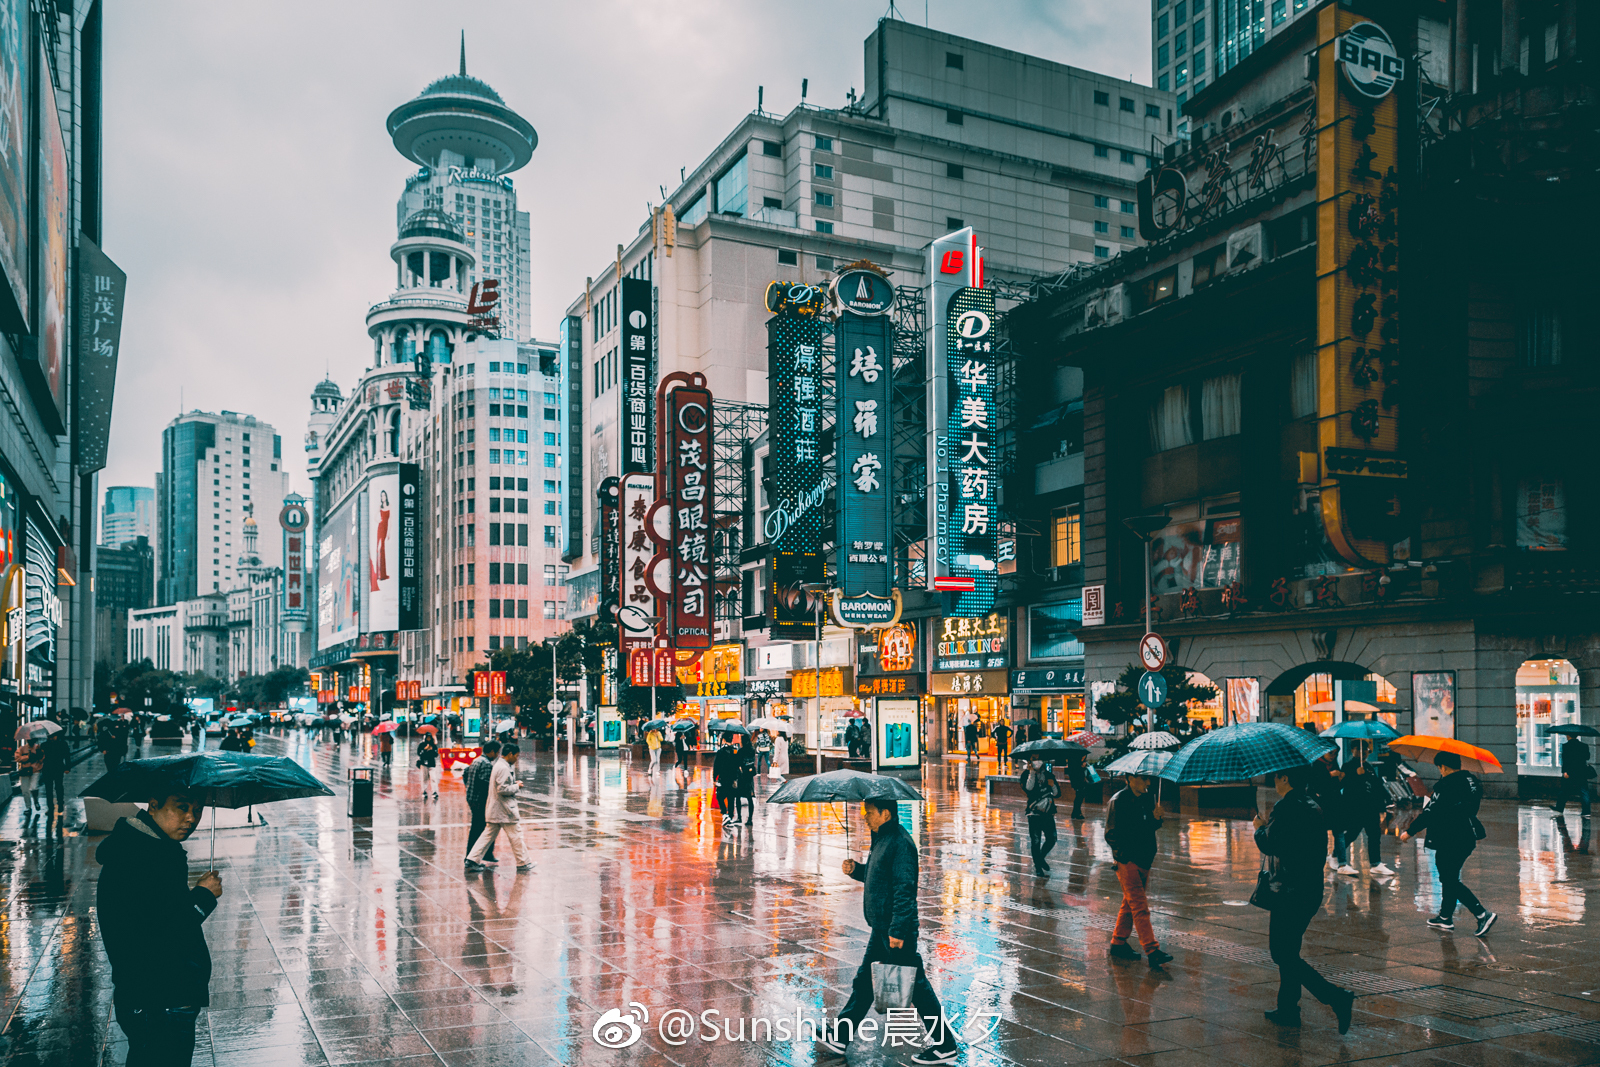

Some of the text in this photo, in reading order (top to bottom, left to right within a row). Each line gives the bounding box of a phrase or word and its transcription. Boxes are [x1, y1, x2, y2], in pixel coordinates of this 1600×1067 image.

[1339, 41, 1403, 79] BAC
[449, 165, 503, 186] Radisson
[93, 275, 115, 357] 世茂广场
[956, 339, 991, 352] 第一医药
[630, 334, 646, 464] 第一百货商业中心
[960, 359, 990, 535] 华美大药房
[403, 498, 415, 578] 第一百货商业中心
[678, 438, 709, 618] 茂昌眼镜公司
[764, 477, 831, 545] Duchamp
[936, 482, 949, 566] Pharmacy
[627, 494, 651, 604] 泰康食品
[848, 554, 888, 563] 西服公司
[678, 627, 709, 636] OPTICAL
[841, 602, 892, 612] BAROMON
[938, 641, 966, 656] SILK
